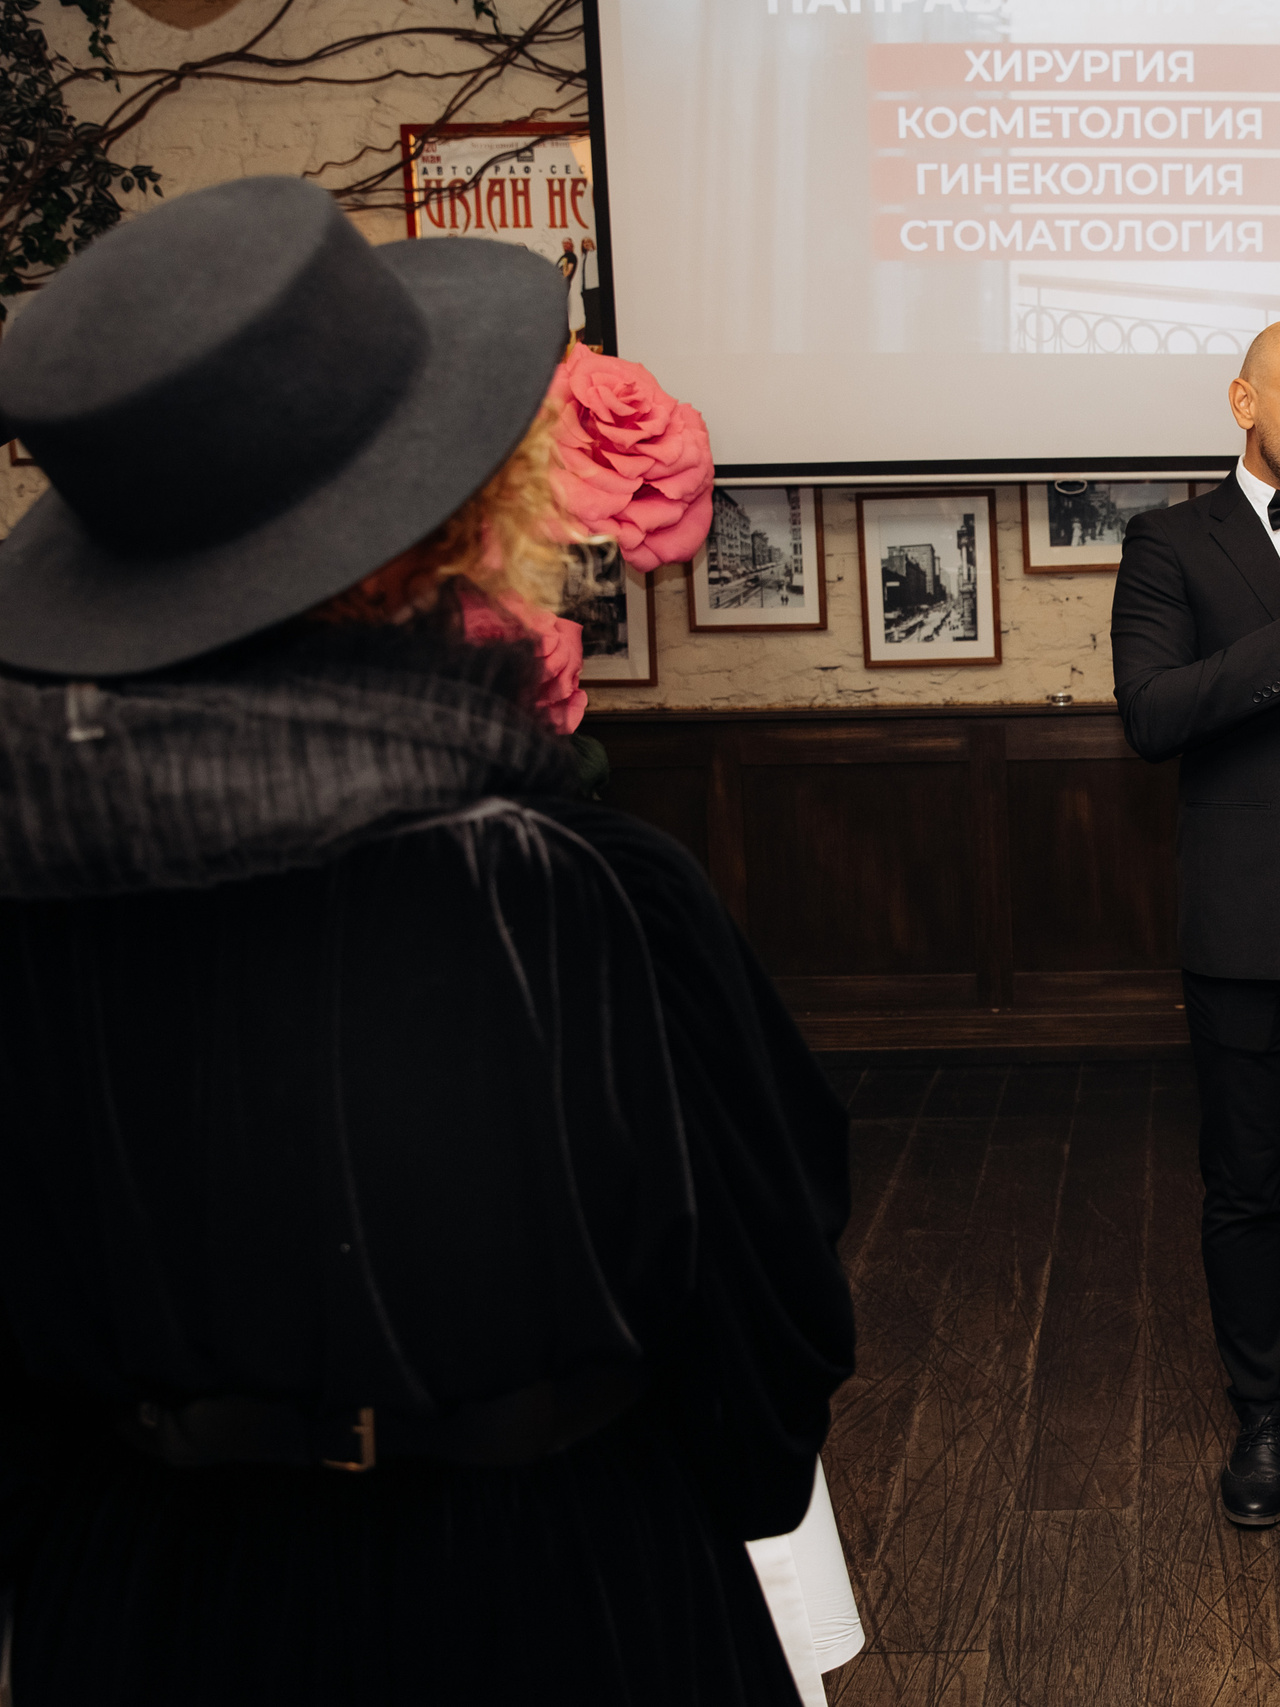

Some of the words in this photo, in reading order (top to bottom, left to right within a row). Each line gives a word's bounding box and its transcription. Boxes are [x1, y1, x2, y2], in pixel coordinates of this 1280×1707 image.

[964, 49, 1195, 83] ХИРУРГИЯ
[898, 107, 1264, 140] КОСМЕТОЛОГИЯ
[916, 163, 1244, 196] ГИНЕКОЛОГИЯ
[423, 178, 533, 234] URIAH
[899, 219, 1264, 253] СТОМАТОЛОГИЯ
